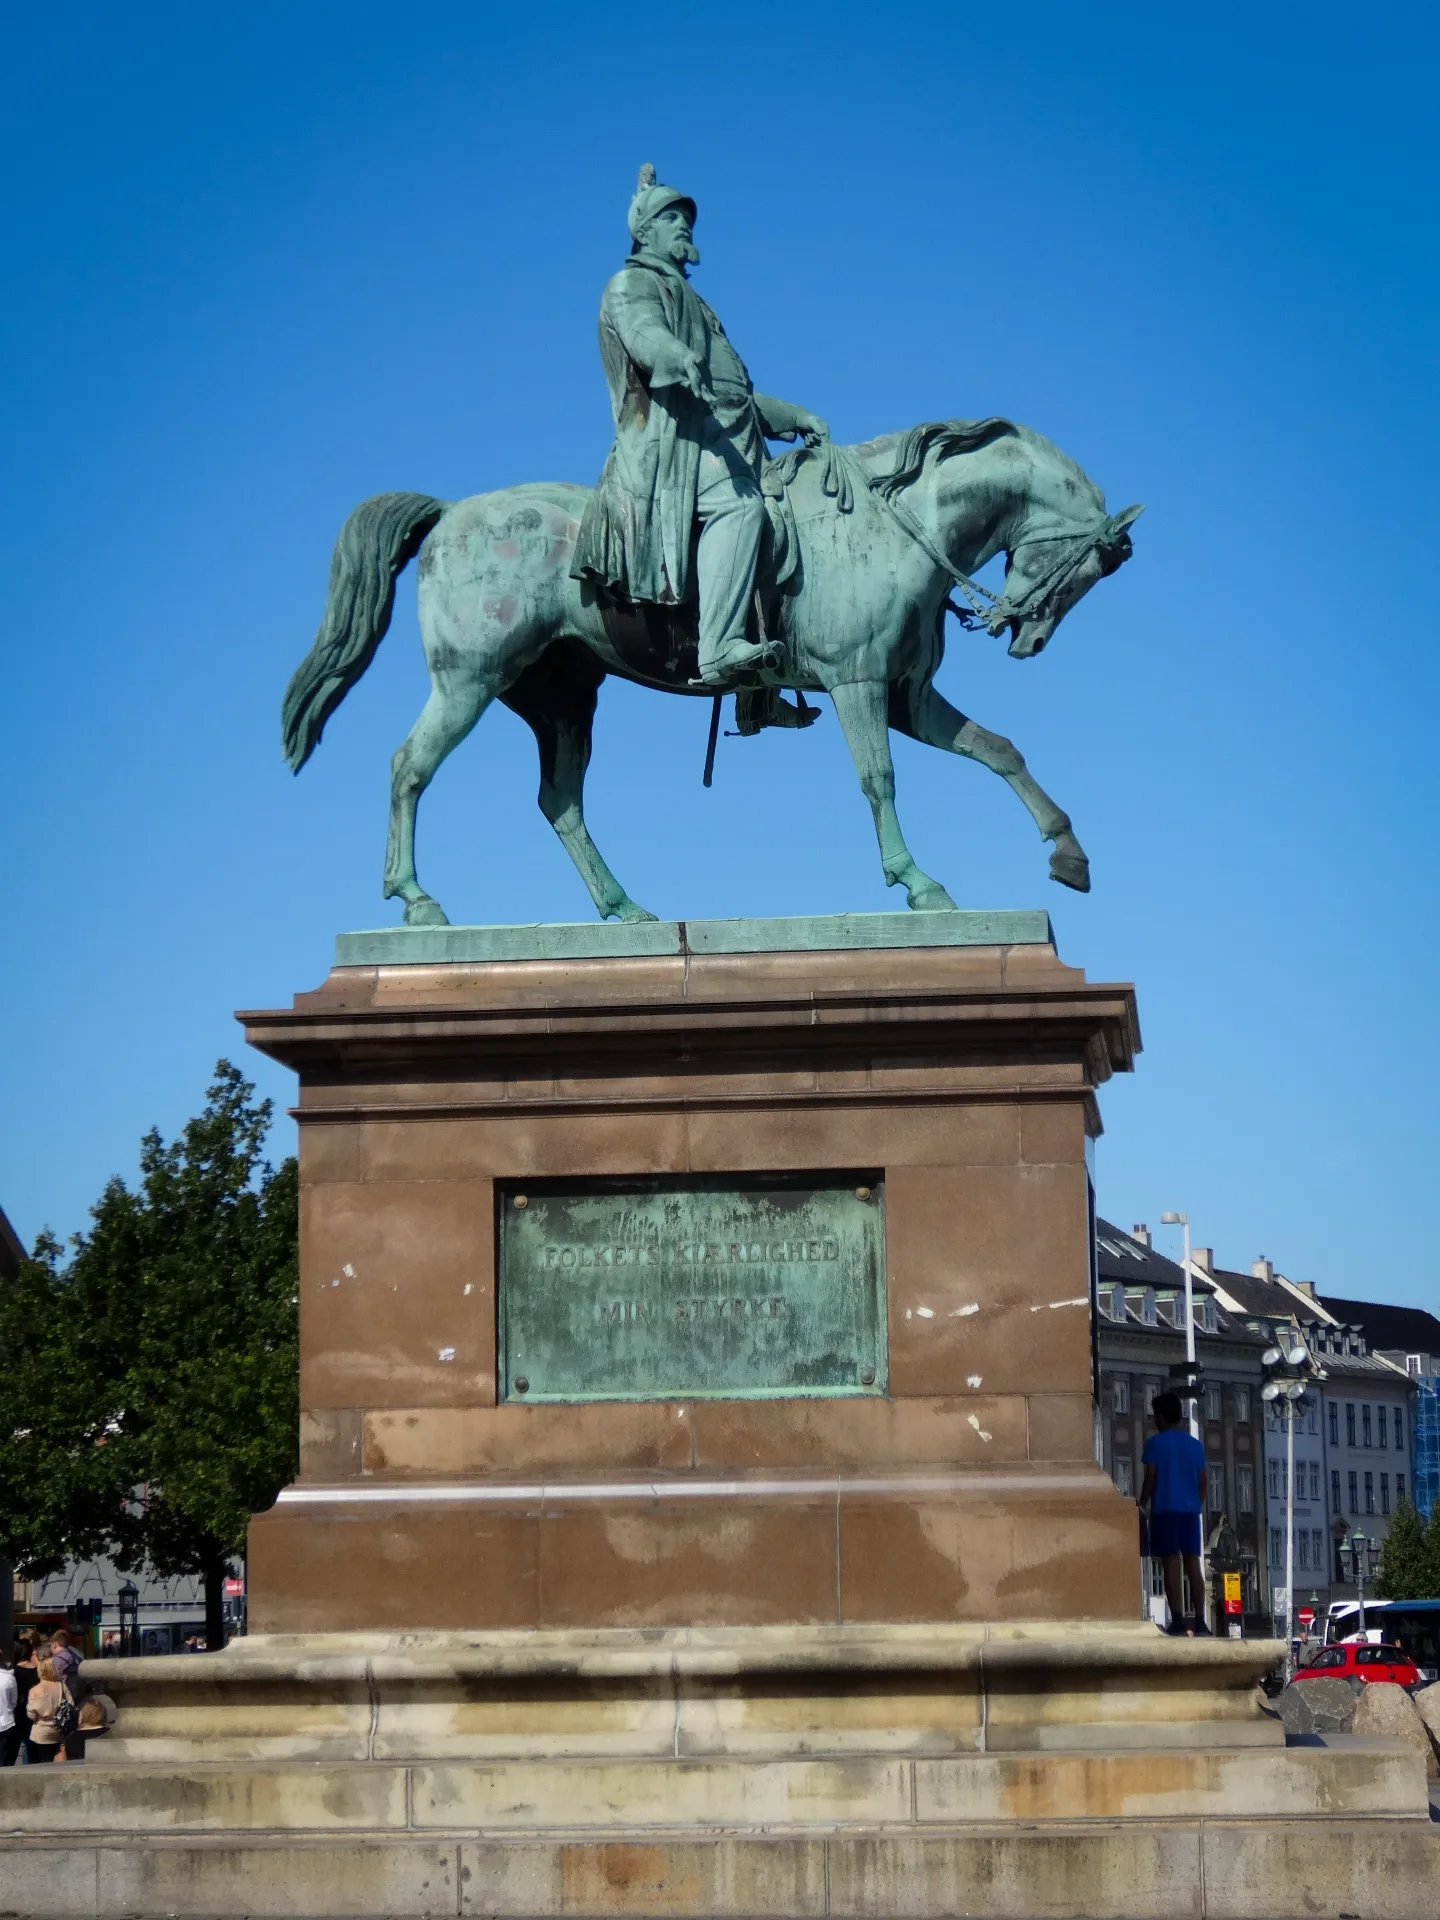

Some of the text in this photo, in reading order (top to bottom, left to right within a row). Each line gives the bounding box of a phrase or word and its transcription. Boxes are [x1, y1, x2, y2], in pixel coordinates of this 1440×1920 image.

[544, 1240, 840, 1268] FOLKETS KIÆRLIGHED
[599, 1297, 788, 1323] MIN STYRKE
